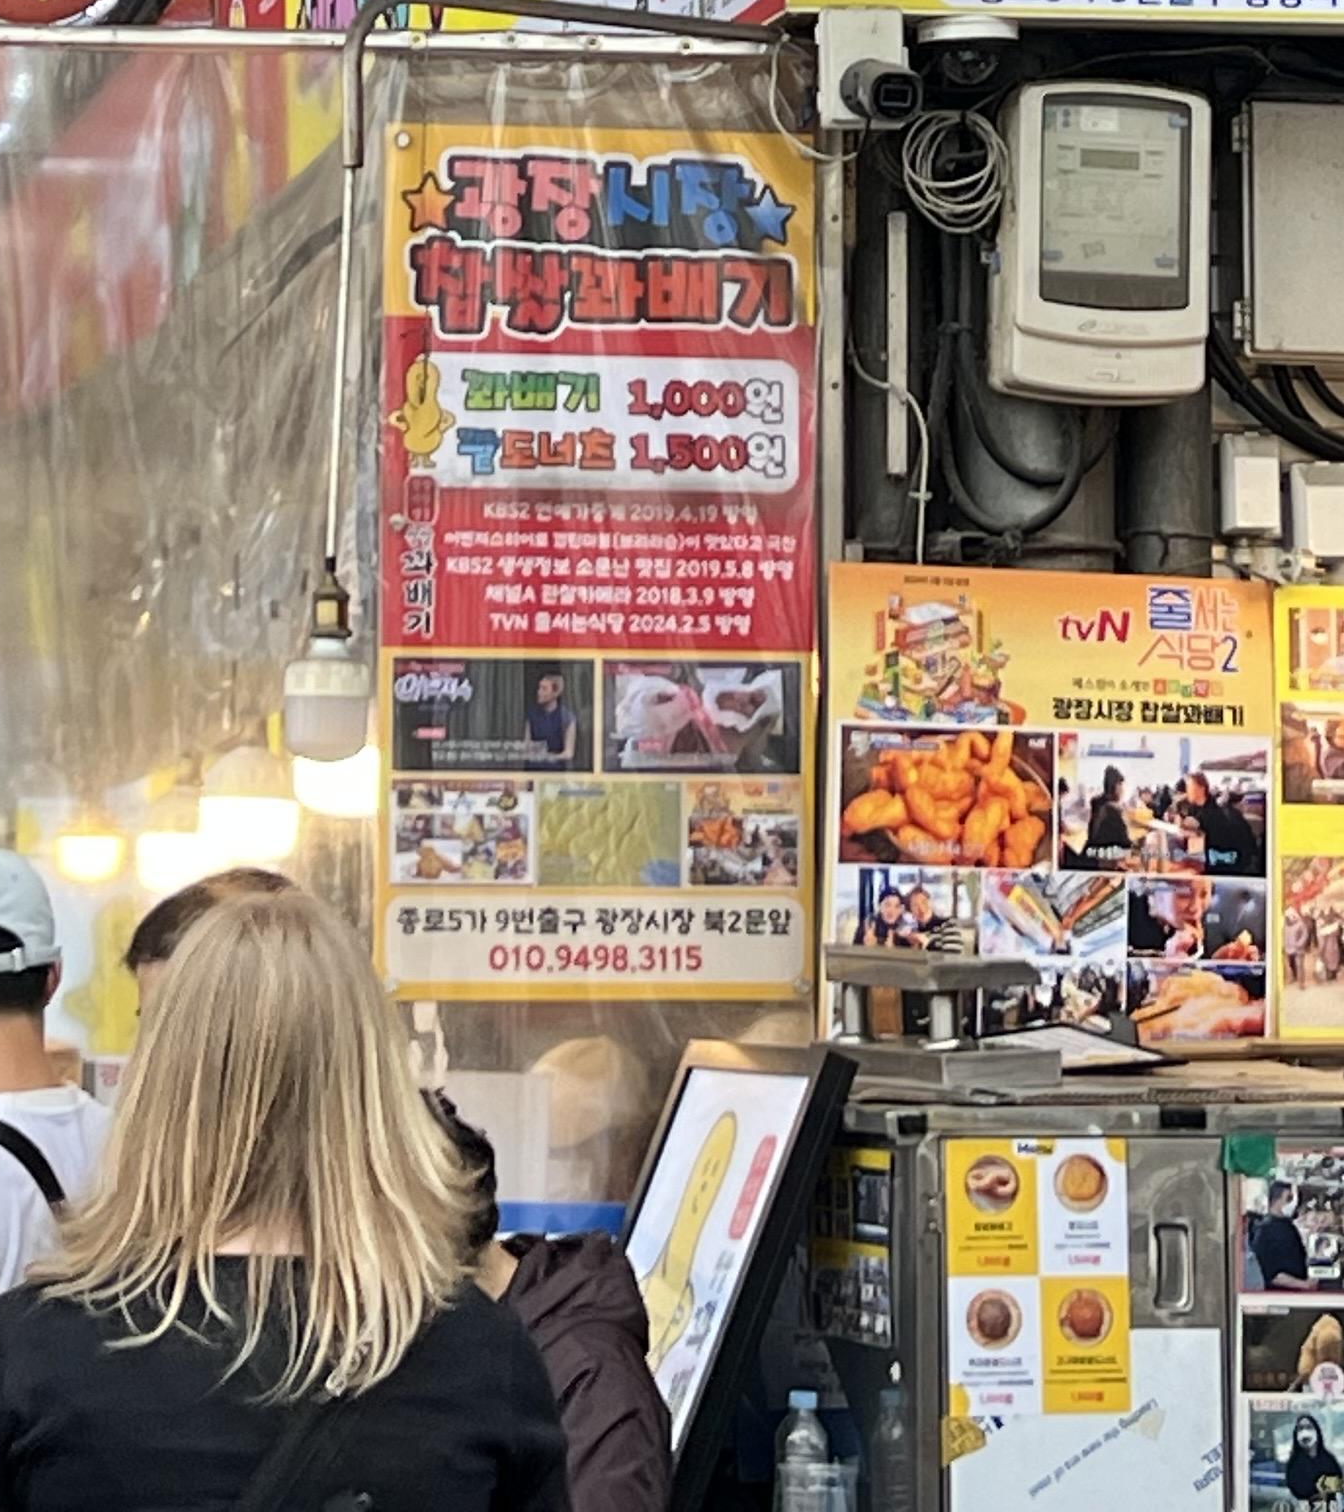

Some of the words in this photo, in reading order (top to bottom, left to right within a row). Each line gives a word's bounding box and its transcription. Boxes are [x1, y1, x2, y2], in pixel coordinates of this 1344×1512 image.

[450, 156, 753, 246] 광장시장
[414, 237, 793, 334] 찹쌀꽈배기
[460, 367, 602, 413] 꽈배기
[626, 378, 786, 426] 1,000원
[629, 430, 788, 479] 1,500원
[635, 586, 716, 607] 2018.3.9
[489, 612, 529, 632] TVN
[1058, 608, 1132, 644] tvN
[1052, 696, 1136, 723] 광장시장
[396, 906, 488, 933] 종로5가
[494, 906, 592, 934] 9번출구
[594, 907, 694, 934] 광장시장
[702, 907, 794, 936] 북2문앞
[488, 943, 704, 973] 010.9498.3115
